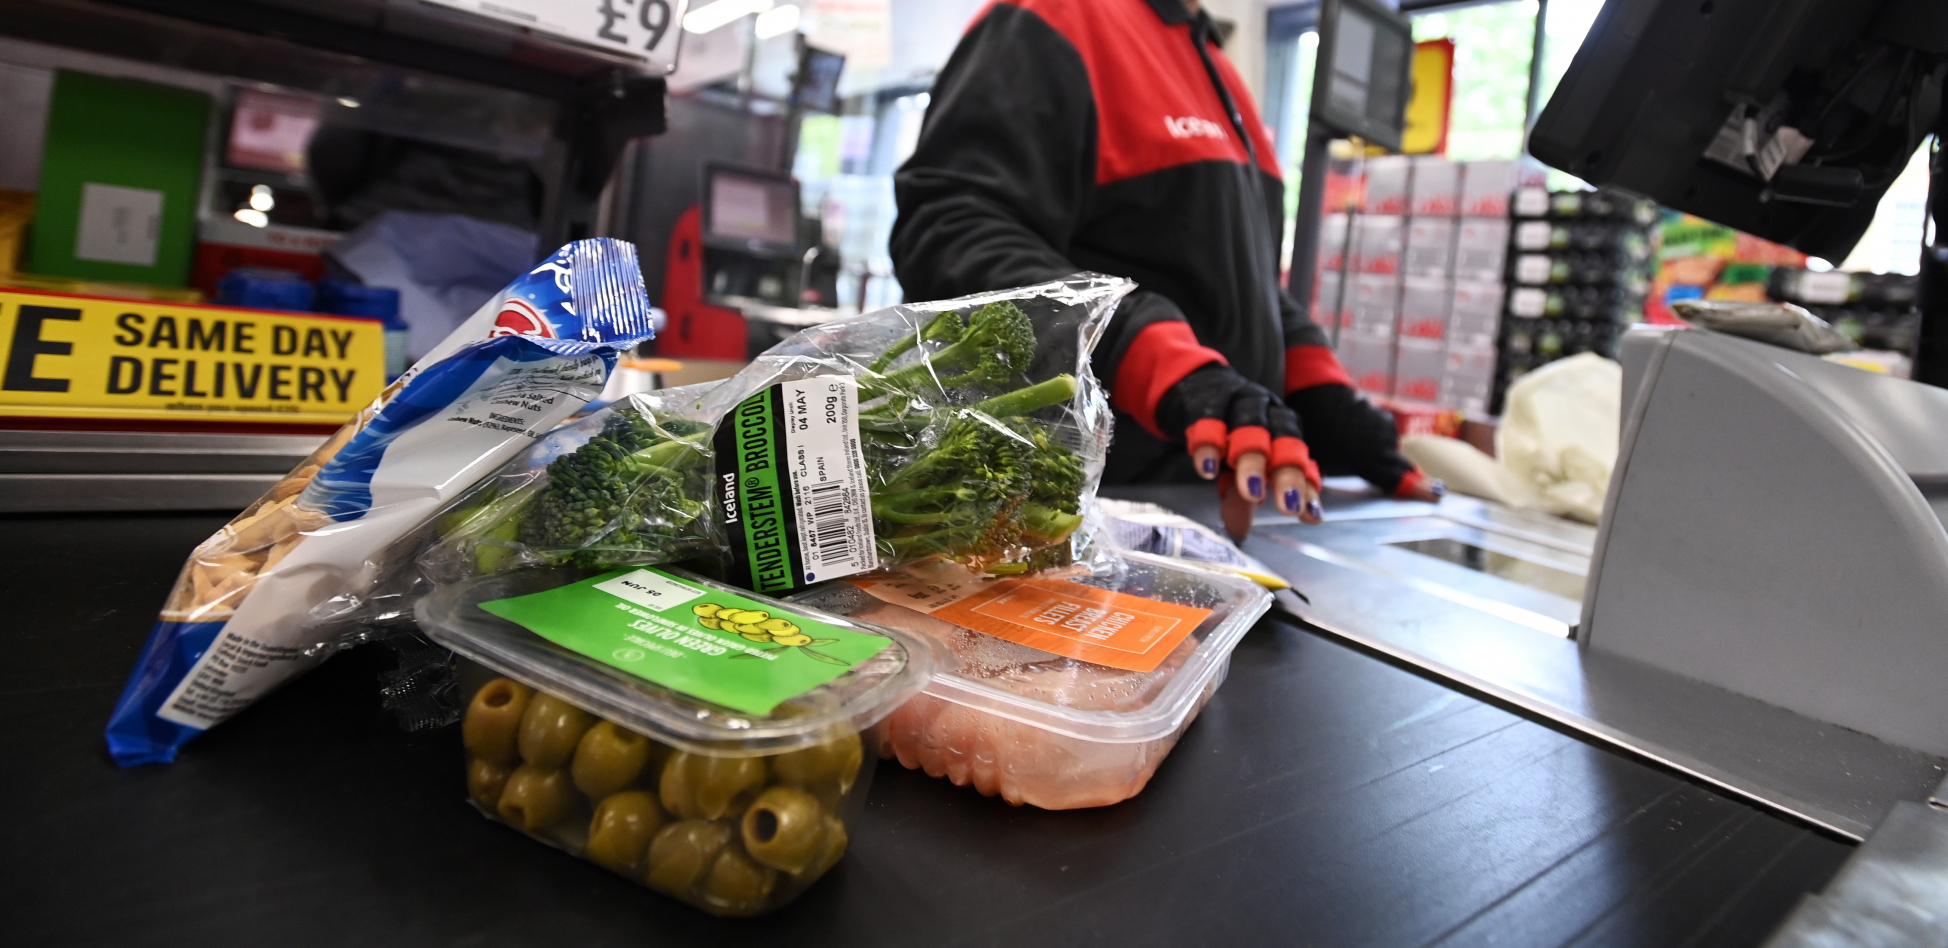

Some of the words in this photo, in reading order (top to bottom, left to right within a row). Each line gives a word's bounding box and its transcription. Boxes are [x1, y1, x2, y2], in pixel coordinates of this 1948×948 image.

[0, 303, 83, 393] E
[114, 313, 256, 354] SAME
[271, 324, 356, 360] DAY
[105, 355, 356, 403] DELIVERY
[521, 401, 542, 412] Nuts
[795, 389, 807, 414] MAY
[825, 396, 838, 424] 200g
[798, 417, 808, 430] 04
[798, 449, 807, 477] CLASS
[816, 456, 827, 481] SPAIN
[723, 472, 738, 524] Iceland
[621, 580, 645, 591] JUN
[646, 589, 662, 597] 05
[629, 608, 679, 629] SUNFLOWER
[1033, 601, 1083, 625] FILLETS
[1061, 608, 1107, 633] BREAST
[627, 619, 676, 640] OLIVES
[686, 628, 716, 642] OLIVES
[1085, 611, 1136, 640] CHICKEN
[673, 636, 727, 656] GREEN
[715, 637, 745, 651] GREEN
